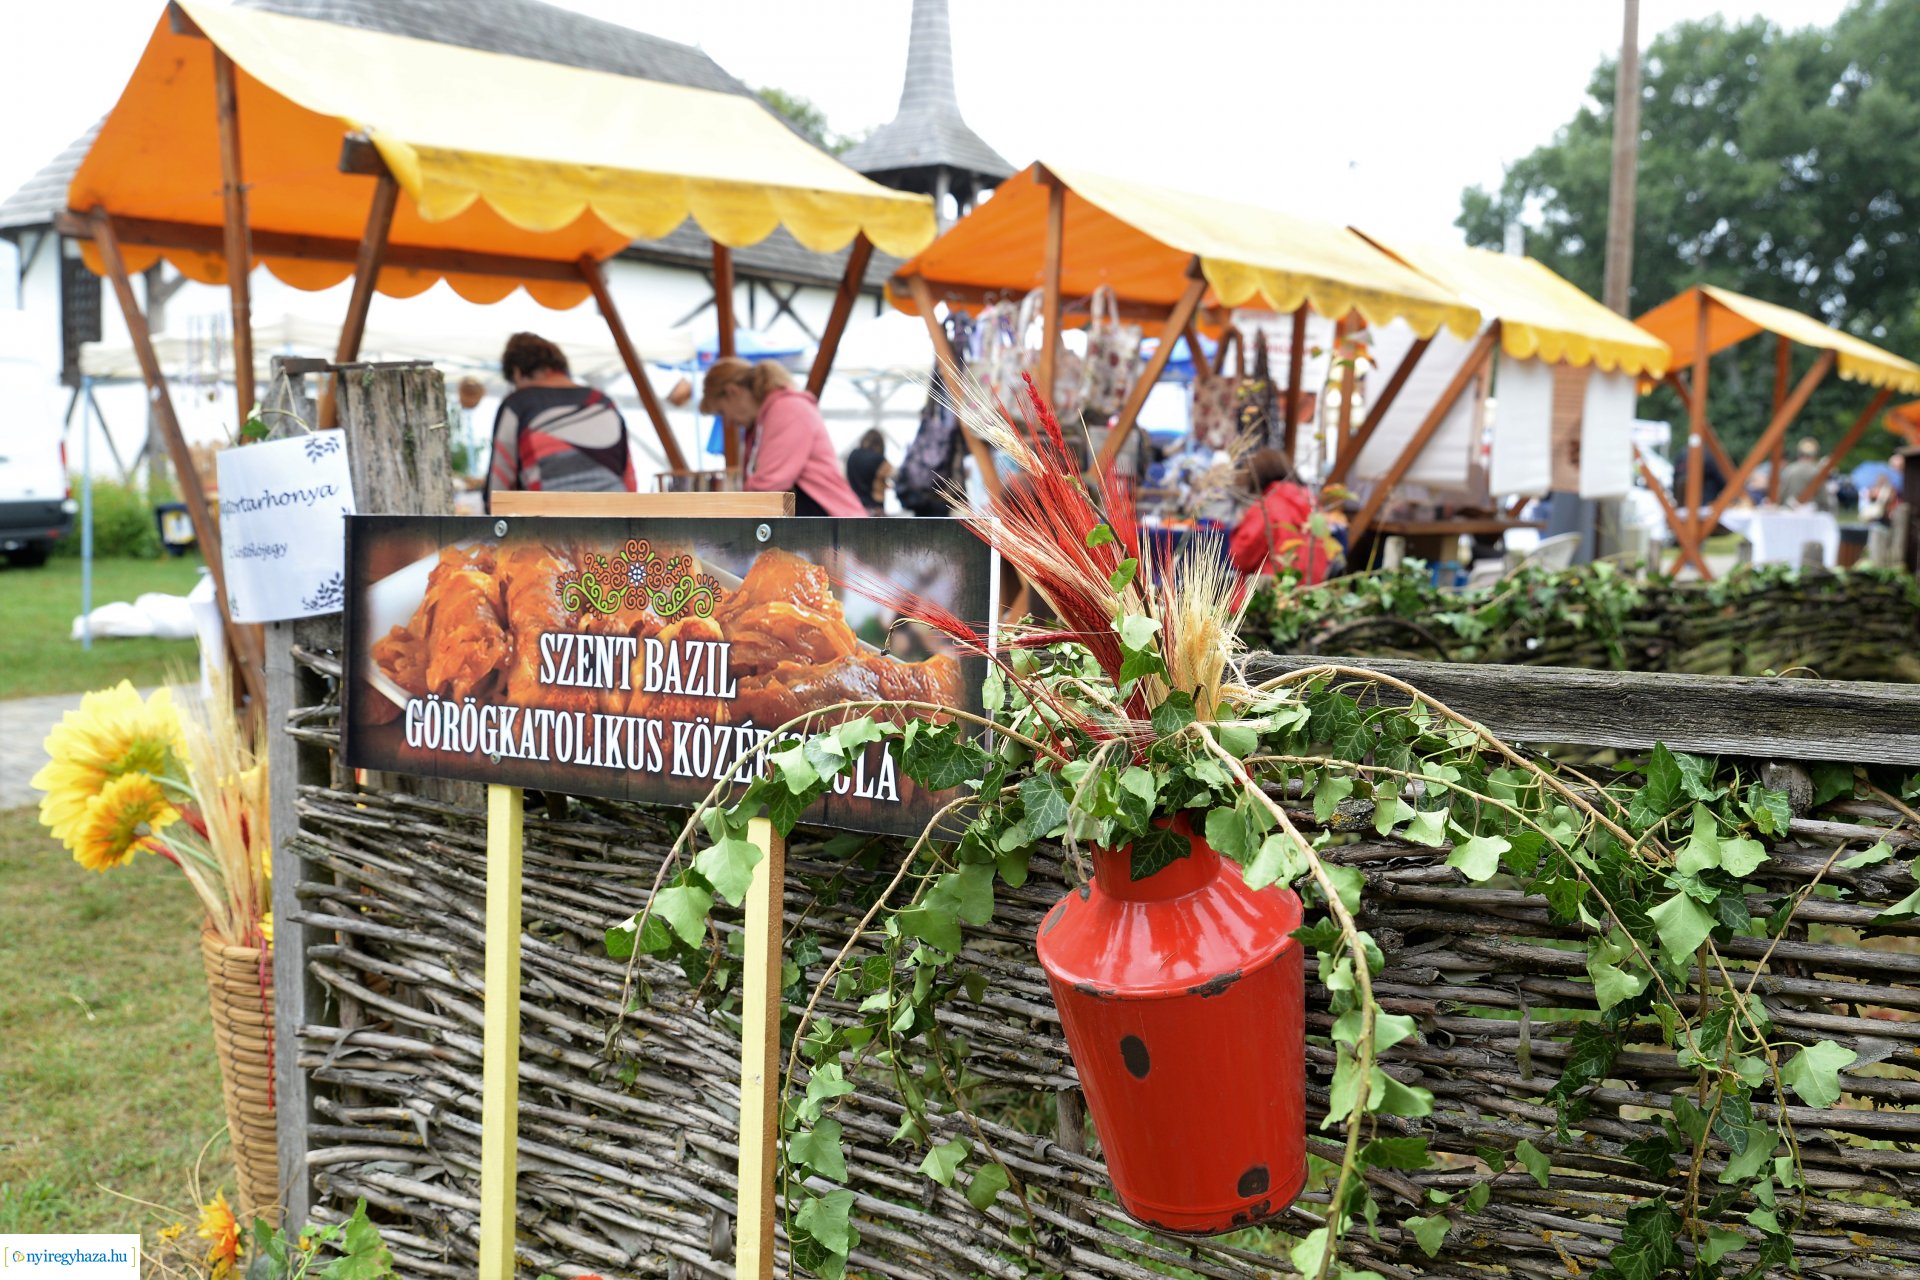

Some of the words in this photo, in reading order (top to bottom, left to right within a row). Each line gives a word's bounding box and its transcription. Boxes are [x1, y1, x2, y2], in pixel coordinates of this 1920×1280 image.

[540, 633, 636, 690] SZENT
[643, 638, 737, 698] BAZIL
[405, 694, 664, 772] GÖRÖGKATOLIKUS
